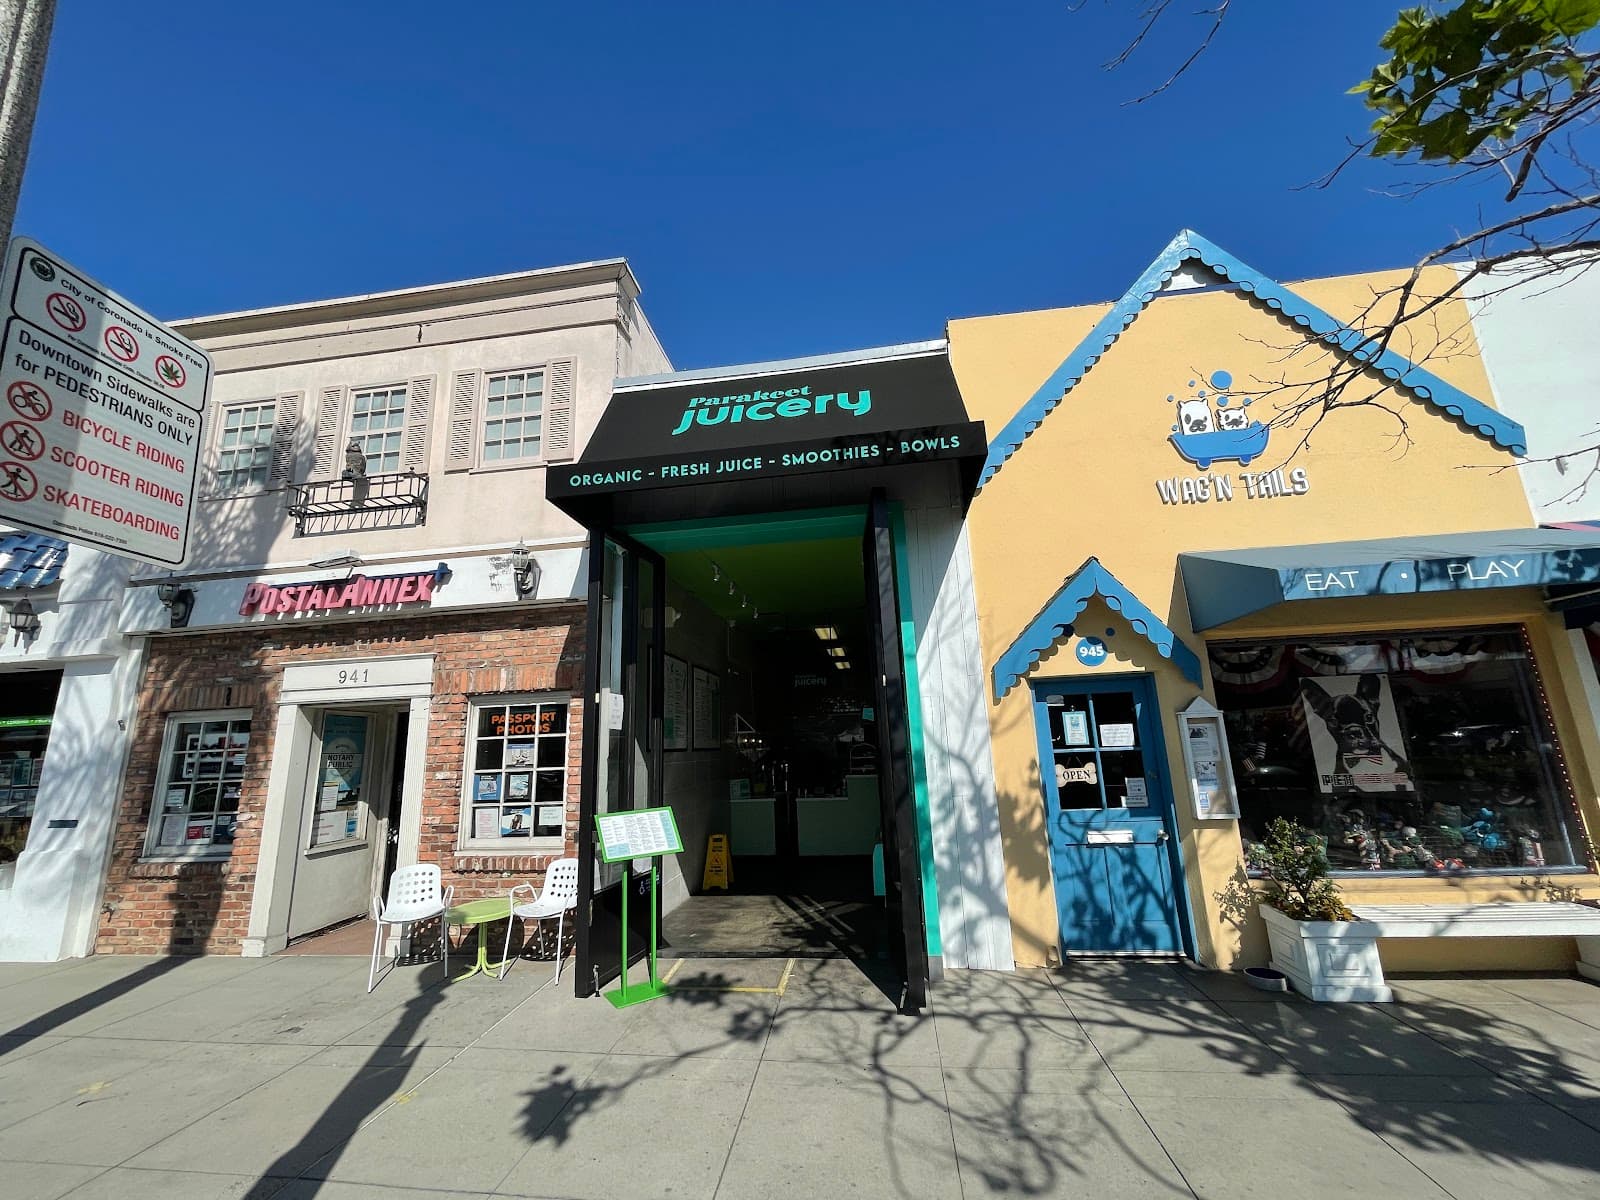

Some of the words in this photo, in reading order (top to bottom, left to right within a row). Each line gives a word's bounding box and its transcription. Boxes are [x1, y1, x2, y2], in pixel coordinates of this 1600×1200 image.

[61, 280, 82, 296] City
[84, 294, 95, 305] of
[97, 301, 143, 333] Coronado
[145, 329, 153, 339] is
[155, 336, 183, 358] Smoke
[185, 354, 203, 369] Free
[19, 329, 102, 383] Downtown
[107, 374, 173, 418] Sidewalks
[176, 411, 195, 428] are
[15, 353, 38, 376] for
[44, 367, 153, 429] PEDESTRIANS
[158, 420, 193, 446] ONLY
[688, 385, 812, 408] Parakeet
[63, 410, 131, 451] BICYCLE
[136, 442, 185, 473] RIDING
[569, 469, 642, 487] ORGANIC
[661, 462, 710, 478] FRESH
[716, 457, 762, 473] JUICE
[782, 444, 880, 466] SMOOTHIES
[901, 435, 961, 454] BOWLS
[51, 446, 130, 488] SCOOTER
[136, 474, 184, 507] RIDING
[1239, 467, 1310, 499] TAILS
[43, 485, 180, 541] SKATEBOARDING
[1305, 571, 1359, 591] EAT
[1447, 560, 1525, 581] PLAY
[1079, 646, 1105, 657] 945
[338, 668, 369, 685] 941
[491, 711, 557, 724] PASSPORT
[496, 723, 552, 735] PHOTOS
[1063, 770, 1090, 780] OPEN
